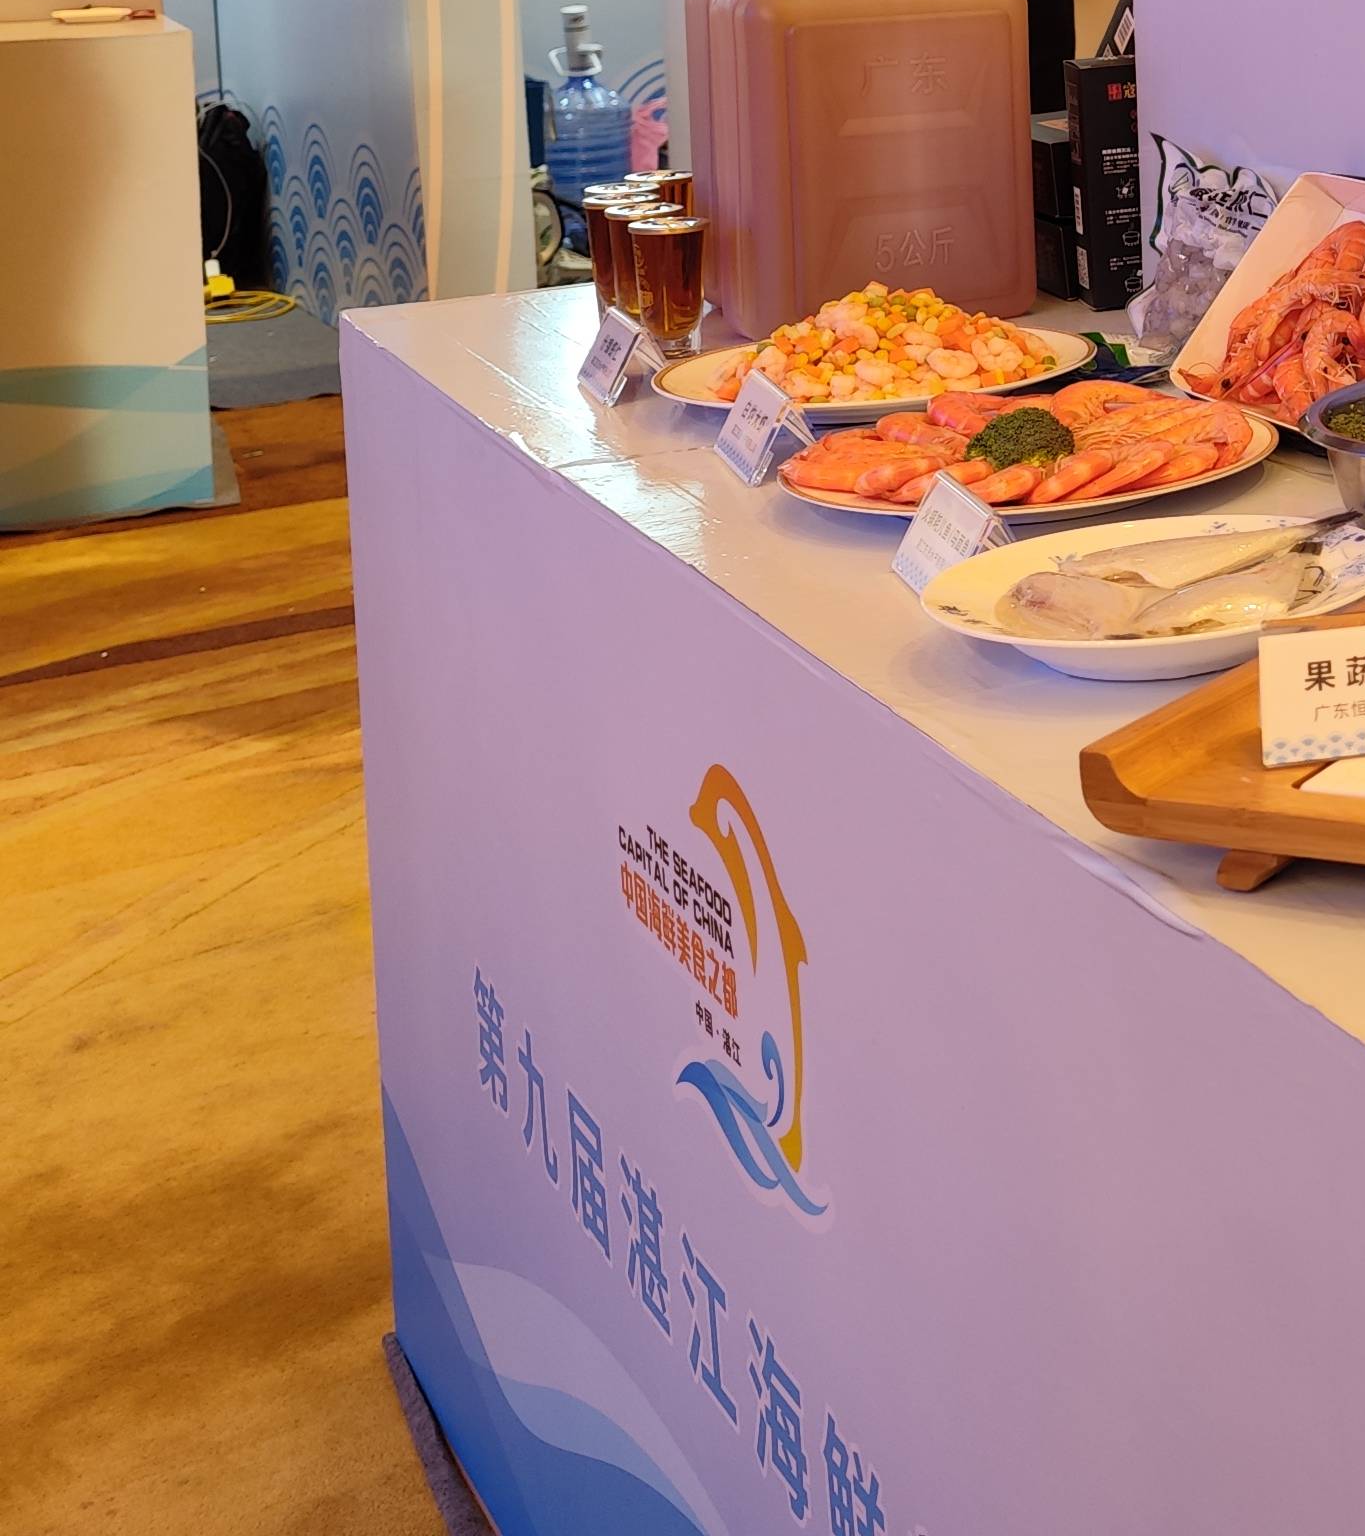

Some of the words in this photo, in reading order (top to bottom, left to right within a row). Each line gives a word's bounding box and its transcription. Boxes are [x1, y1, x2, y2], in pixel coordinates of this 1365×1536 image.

[876, 226, 954, 273] 5公斤
[618, 825, 669, 894] CAPITAL
[673, 879, 689, 910] OF
[693, 898, 734, 959] CHINA
[621, 860, 738, 1019] 中国海鲜美食之都
[647, 825, 669, 866] THE
[672, 850, 732, 927] SEAFOOD
[474, 967, 885, 1536] 第九届湛江海鲜
